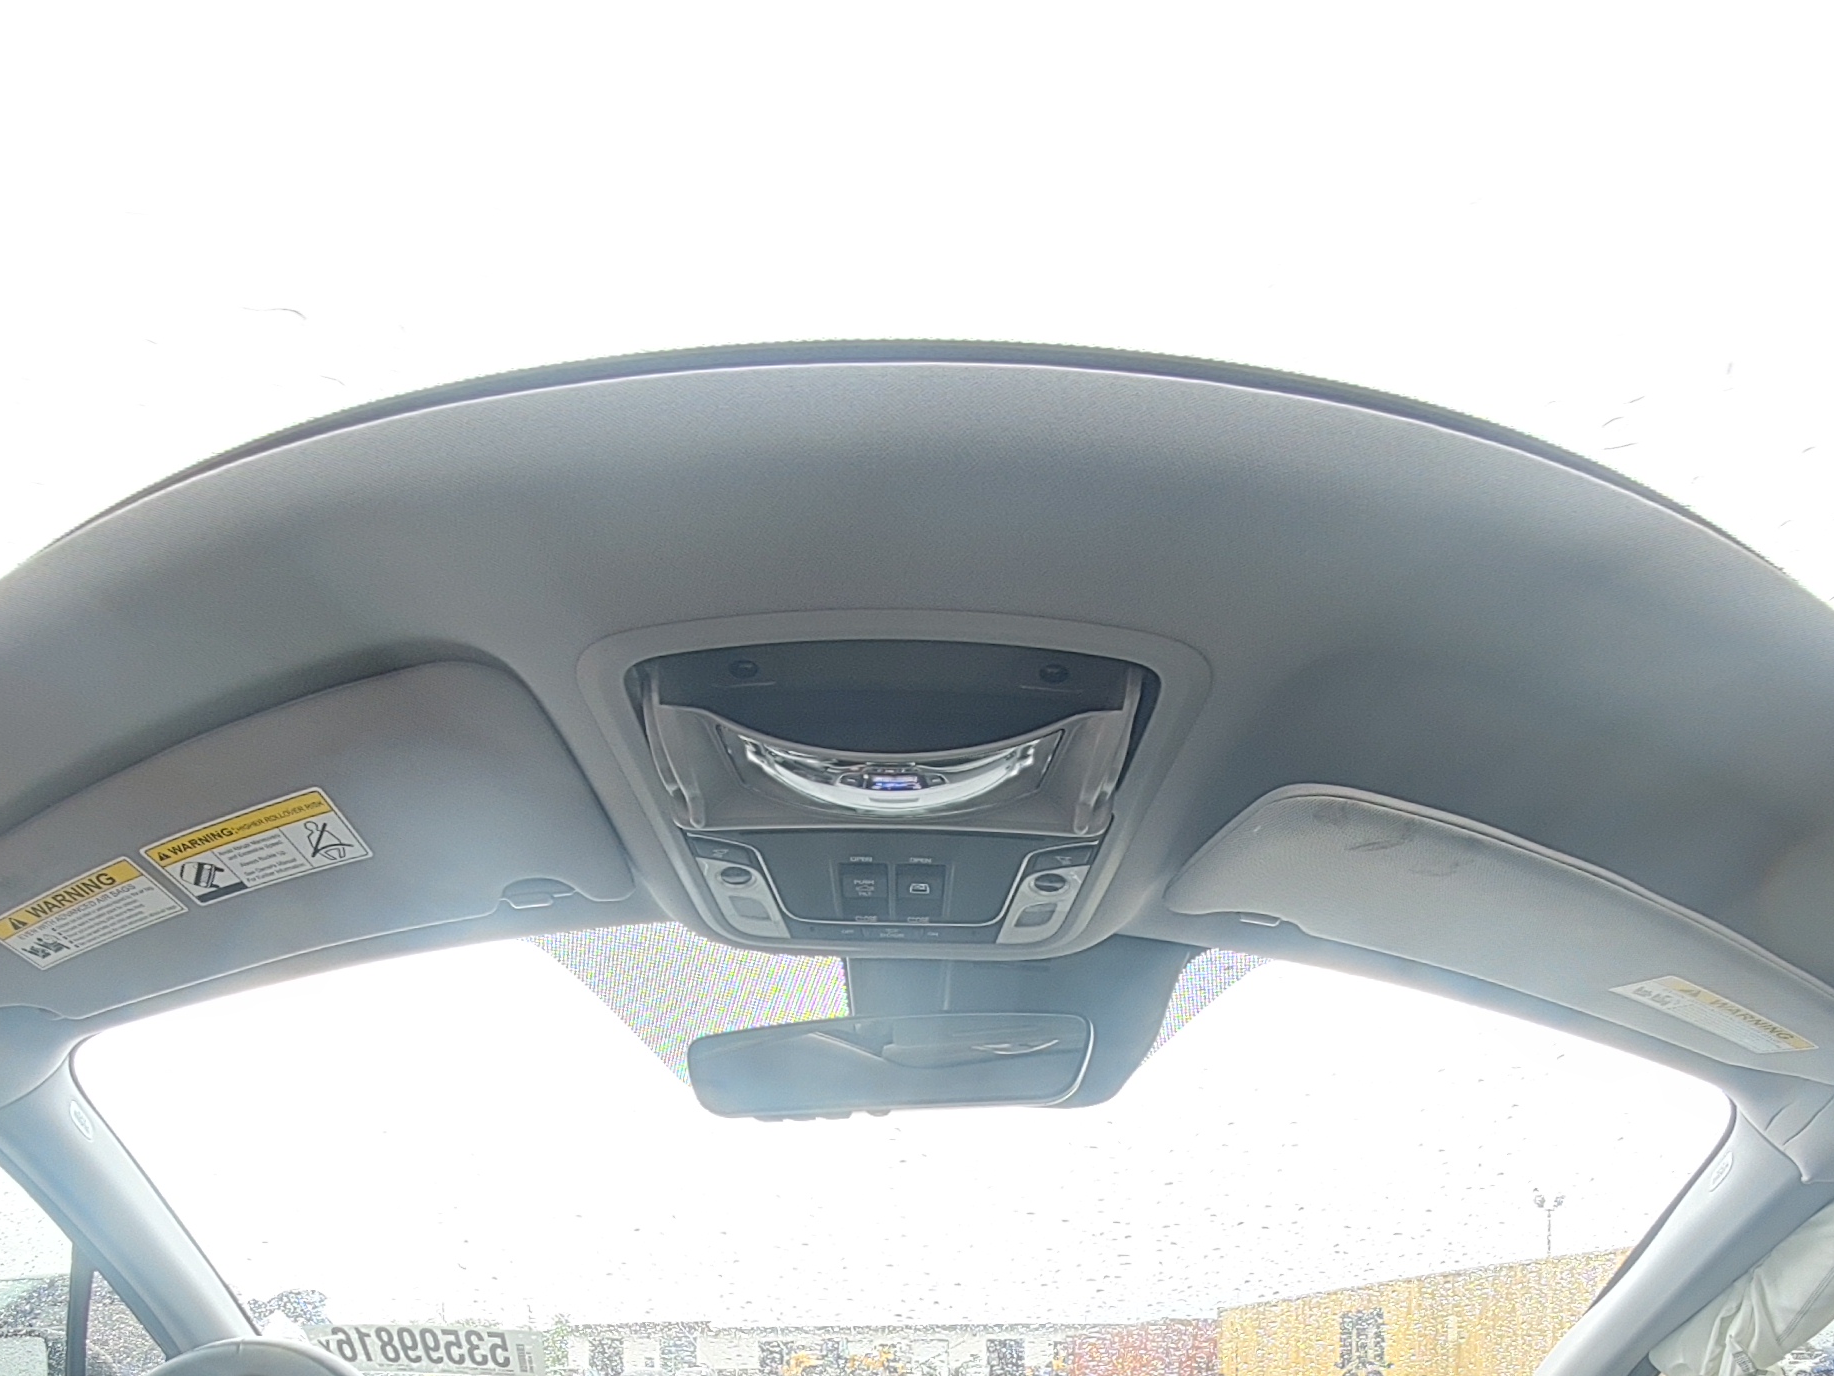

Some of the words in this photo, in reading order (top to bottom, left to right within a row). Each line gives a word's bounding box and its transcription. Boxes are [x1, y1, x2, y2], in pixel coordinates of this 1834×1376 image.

[265, 806, 303, 822] ROLLOVER
[25, 872, 116, 919] WARNING
[55, 900, 98, 923] ADVANCED
[111, 883, 136, 900] BAGS
[1711, 999, 1794, 1041] WARNING
